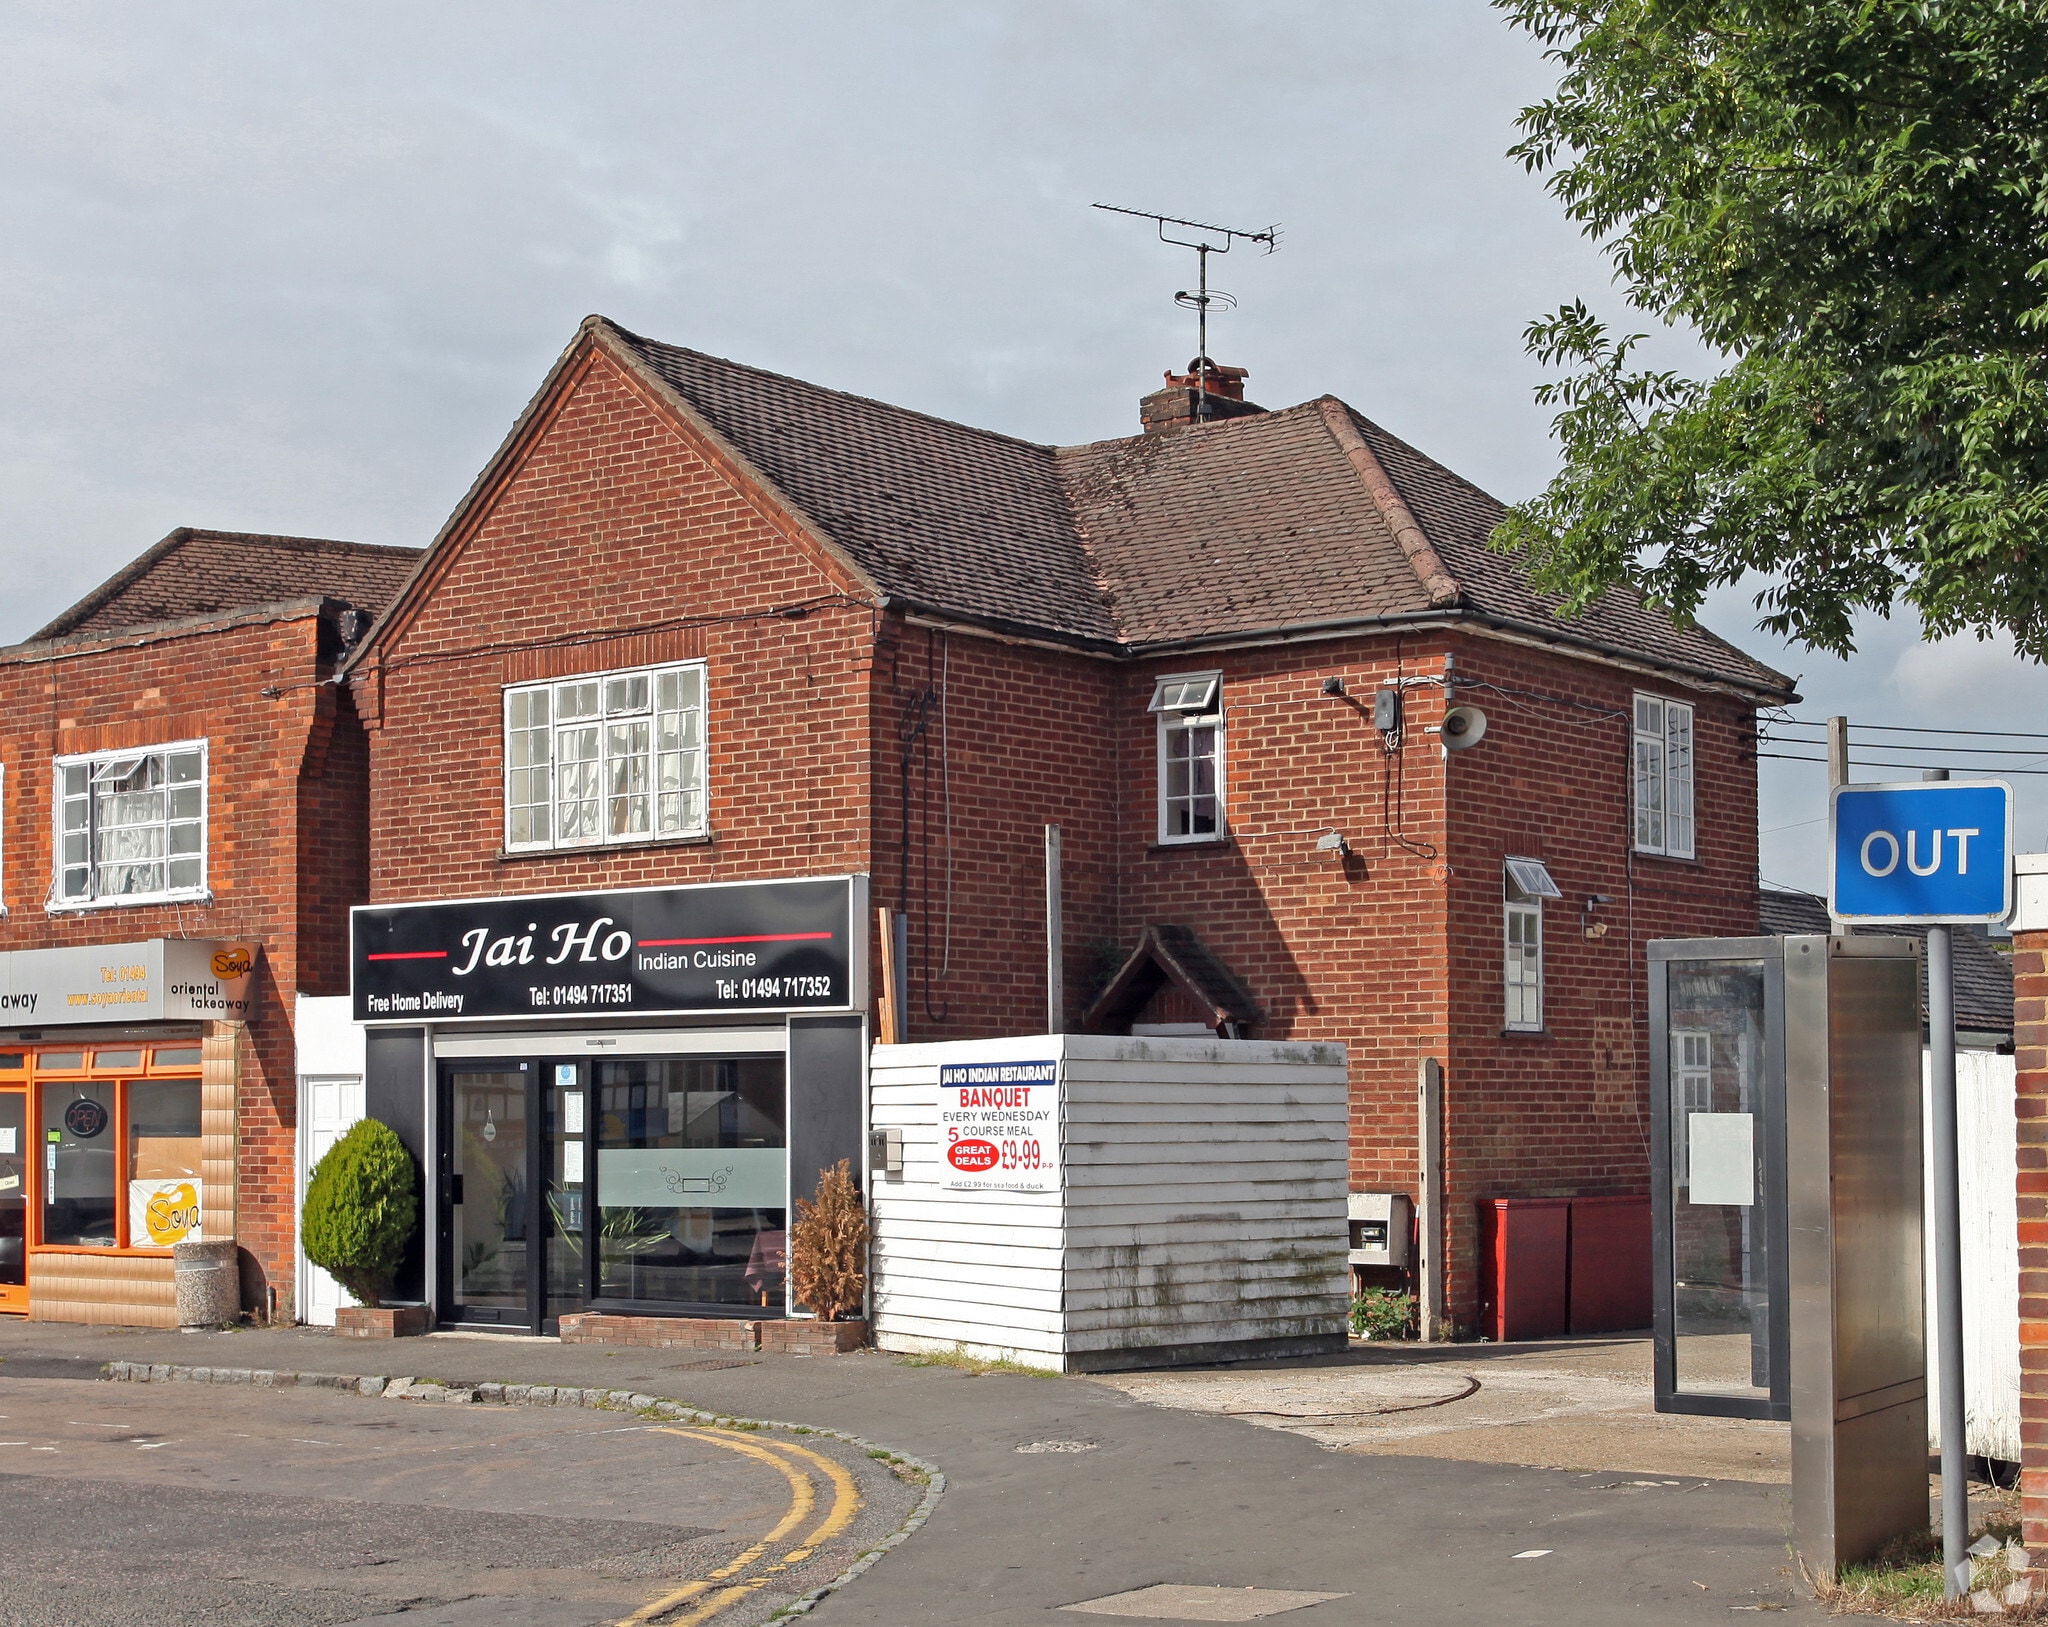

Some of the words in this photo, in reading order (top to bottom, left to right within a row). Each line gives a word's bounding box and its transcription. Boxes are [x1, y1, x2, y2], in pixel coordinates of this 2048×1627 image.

[1860, 828, 1980, 877] OUT
[452, 923, 537, 976] Jai
[546, 917, 632, 965] Ho
[214, 955, 253, 978] Soya
[638, 953, 688, 970] Indian
[694, 950, 756, 968] Cuisine
[101, 966, 117, 983] Tel:
[119, 965, 147, 982] 01494
[171, 981, 218, 995] oriental
[529, 986, 550, 1006] Tel:
[553, 985, 588, 1005] 01494
[591, 983, 632, 1003] 717351
[716, 979, 739, 999] Tel:
[742, 978, 780, 998] 01494
[784, 976, 831, 997] 717352
[1, 993, 38, 1014] away
[191, 997, 249, 1013] takeaway
[368, 994, 389, 1012] Free
[392, 993, 420, 1011] Home
[423, 991, 464, 1013] Delivery
[943, 1068, 953, 1085] JAI
[954, 1068, 967, 1083] HO
[968, 1067, 999, 1082] INDIAN
[1001, 1065, 1055, 1081] RESTAURANT
[960, 1088, 1031, 1110] BANQUET
[67, 1110, 102, 1127] OPEN
[943, 1111, 978, 1121] EVERY
[981, 1111, 1050, 1121] WEDNESDAY
[948, 1127, 959, 1142] 5
[963, 1126, 1004, 1136] COURSE
[1007, 1126, 1033, 1136] MEAL
[955, 1145, 991, 1155] GREAT
[1002, 1139, 1040, 1170] £9.99
[955, 1156, 991, 1166] DEALS
[151, 1200, 202, 1240] Soya
